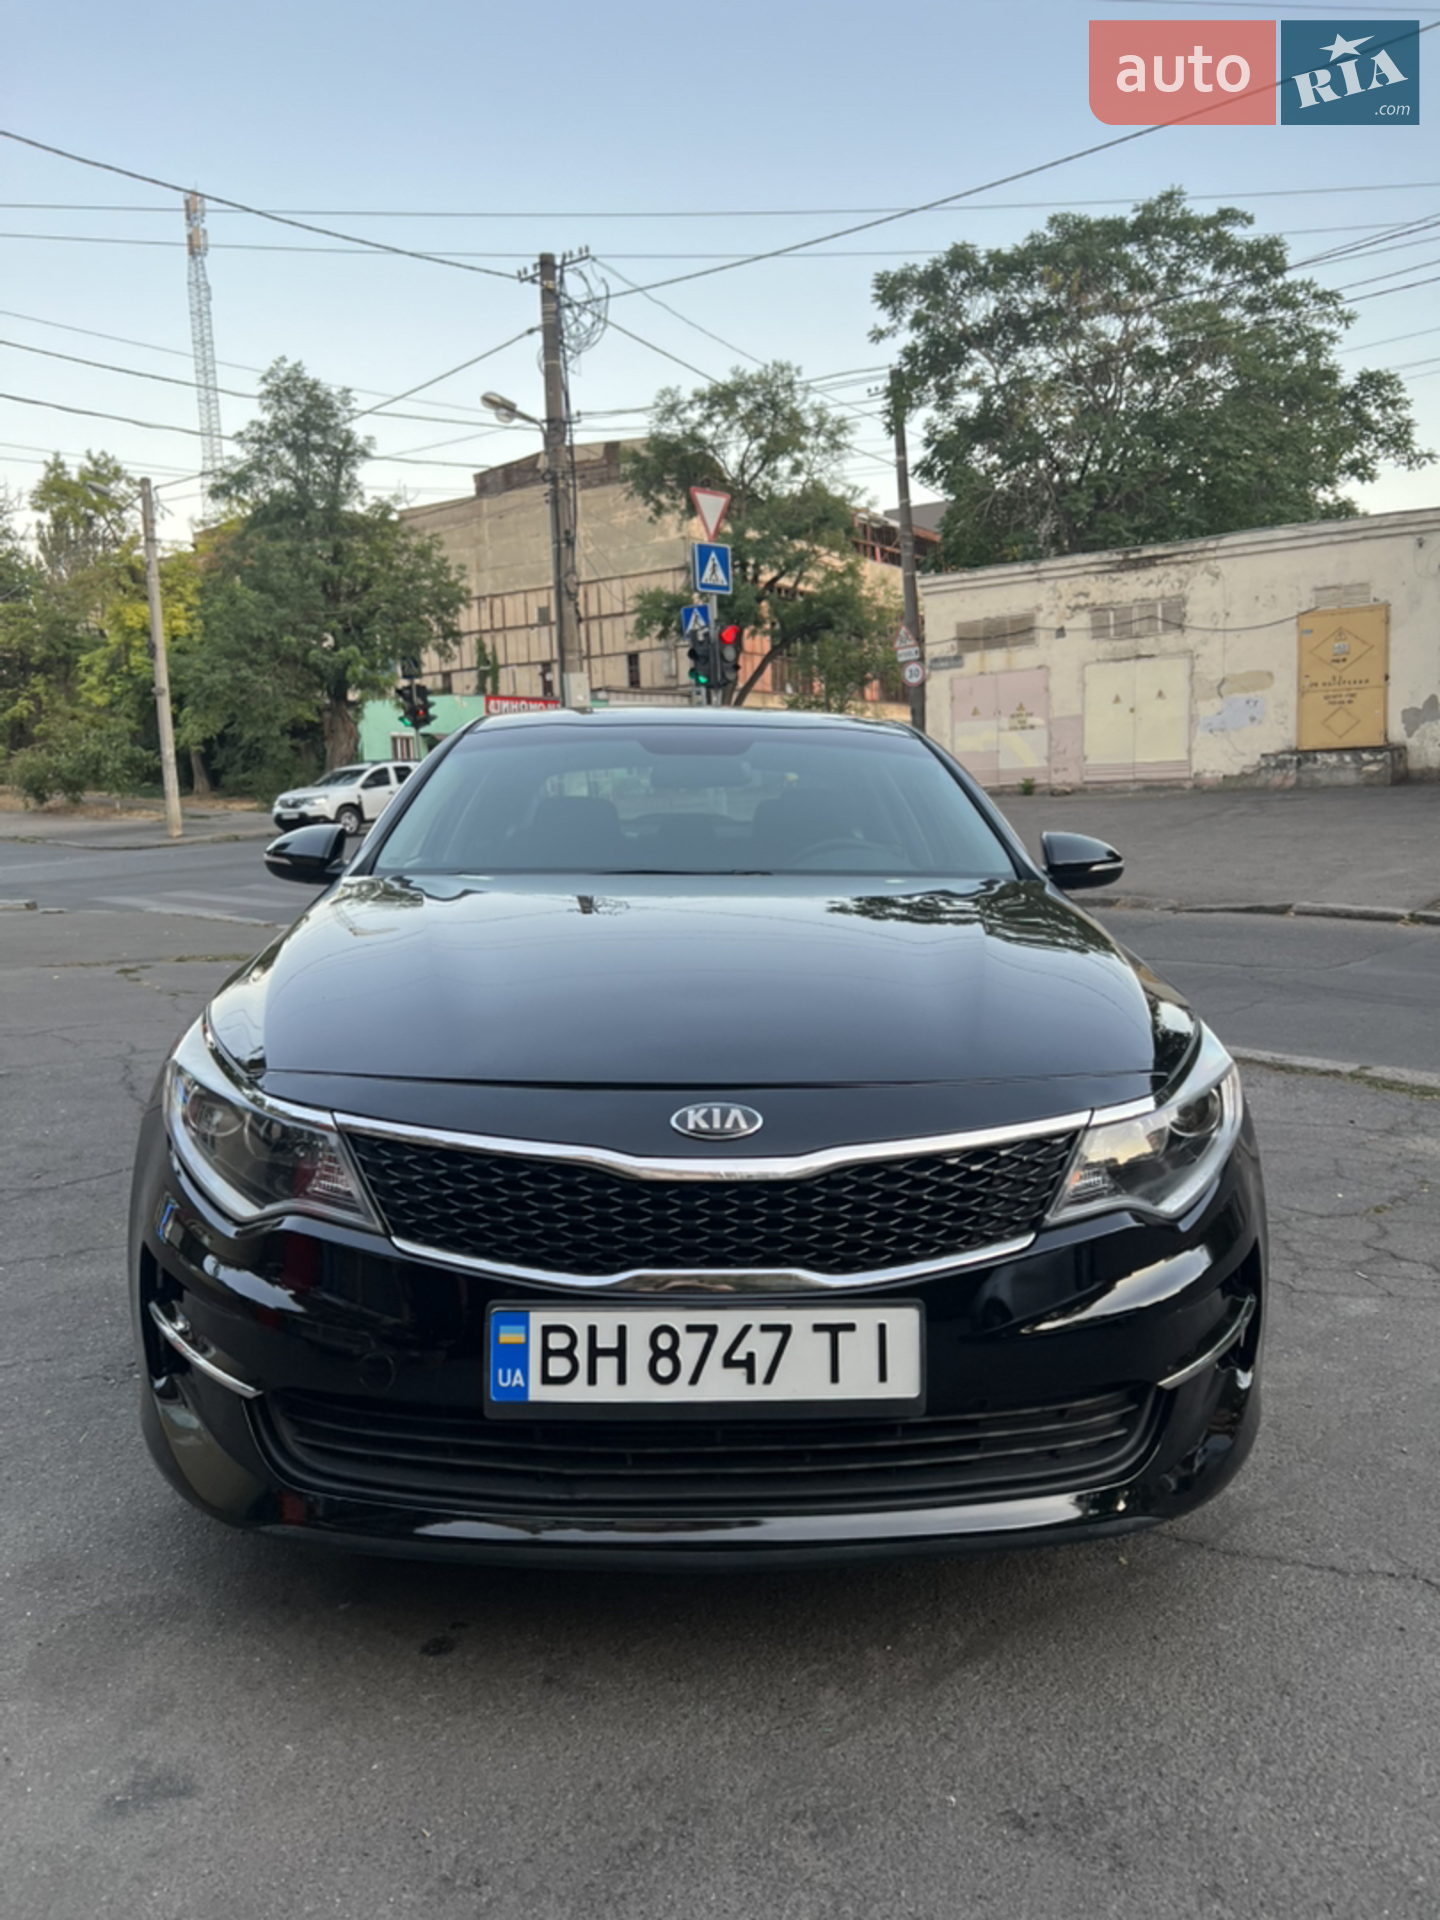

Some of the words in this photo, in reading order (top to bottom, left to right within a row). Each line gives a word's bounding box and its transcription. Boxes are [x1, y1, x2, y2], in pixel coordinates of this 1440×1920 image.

[687, 1107, 748, 1130] KIA
[541, 1324, 627, 1386] BH
[647, 1323, 793, 1386] 8747
[497, 1367, 525, 1388] UA
